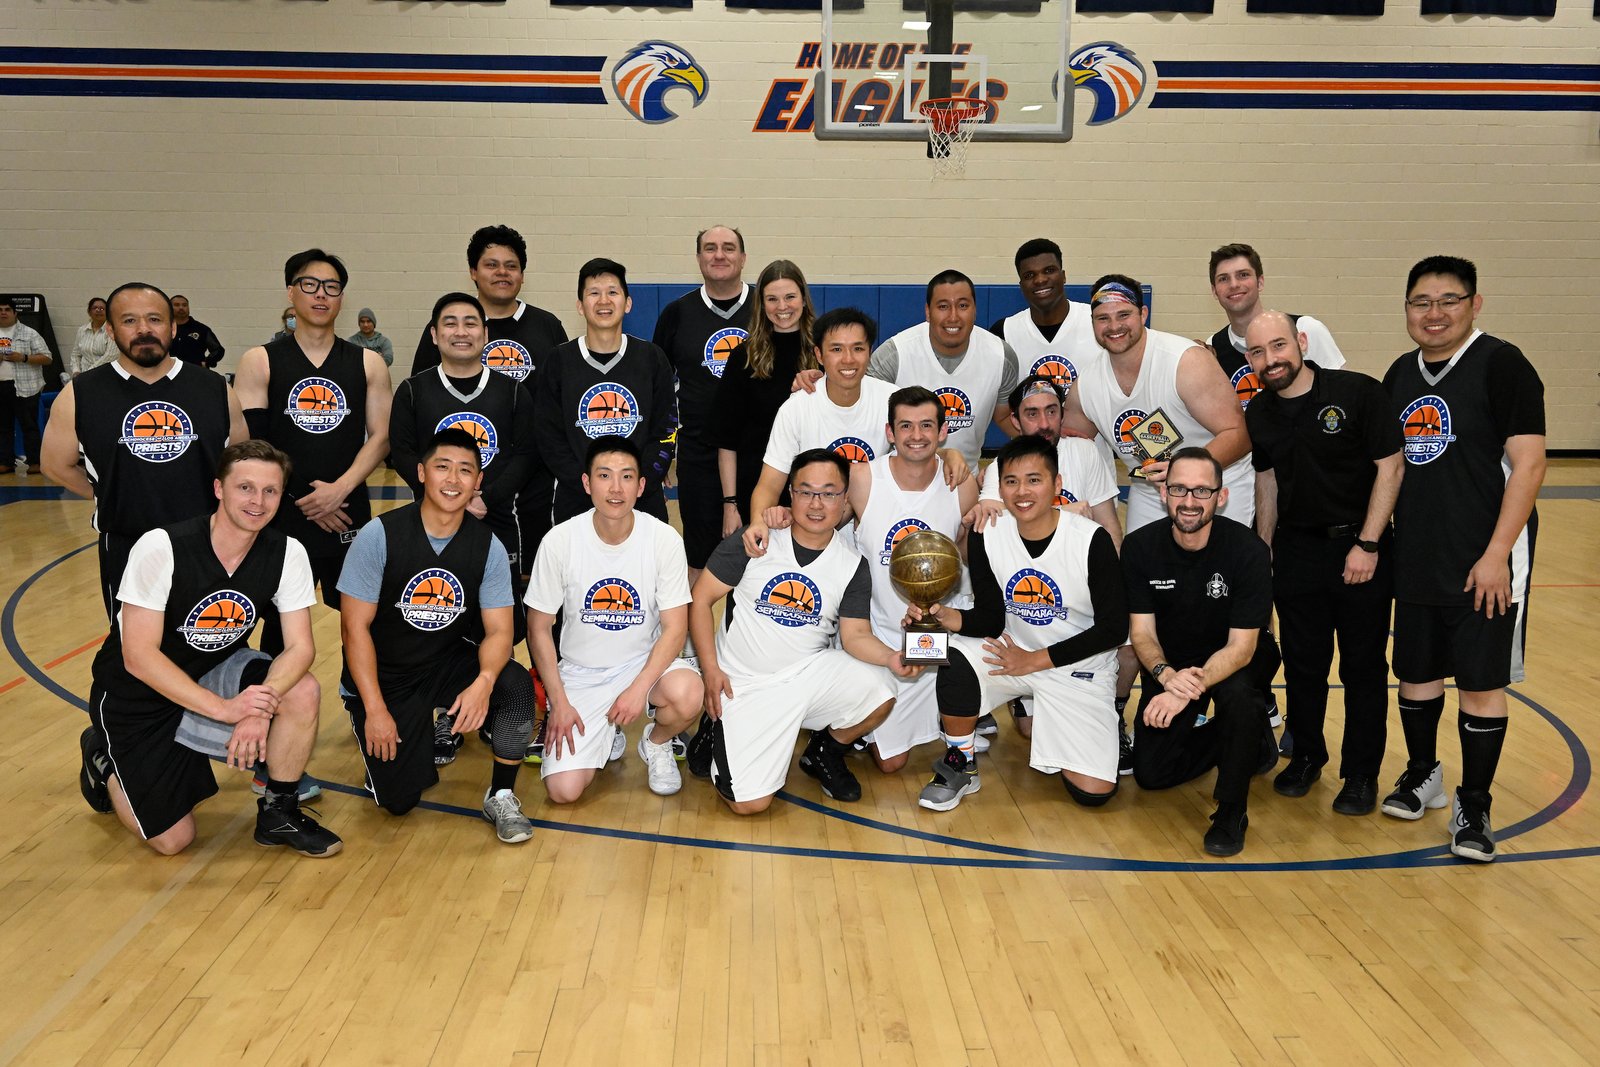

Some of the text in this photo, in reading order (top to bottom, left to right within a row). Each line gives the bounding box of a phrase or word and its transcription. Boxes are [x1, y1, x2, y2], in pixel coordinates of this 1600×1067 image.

[878, 42, 917, 70] OF
[916, 43, 973, 70] TE
[297, 415, 337, 424] PRIESTS
[589, 423, 629, 434] PRIESTS
[134, 442, 182, 453] PRIESTS
[1405, 442, 1440, 453] PRIESTS
[407, 610, 450, 621] PRIESTS
[582, 614, 643, 624] SEMINARIANS
[190, 633, 238, 642] PRIESTS
